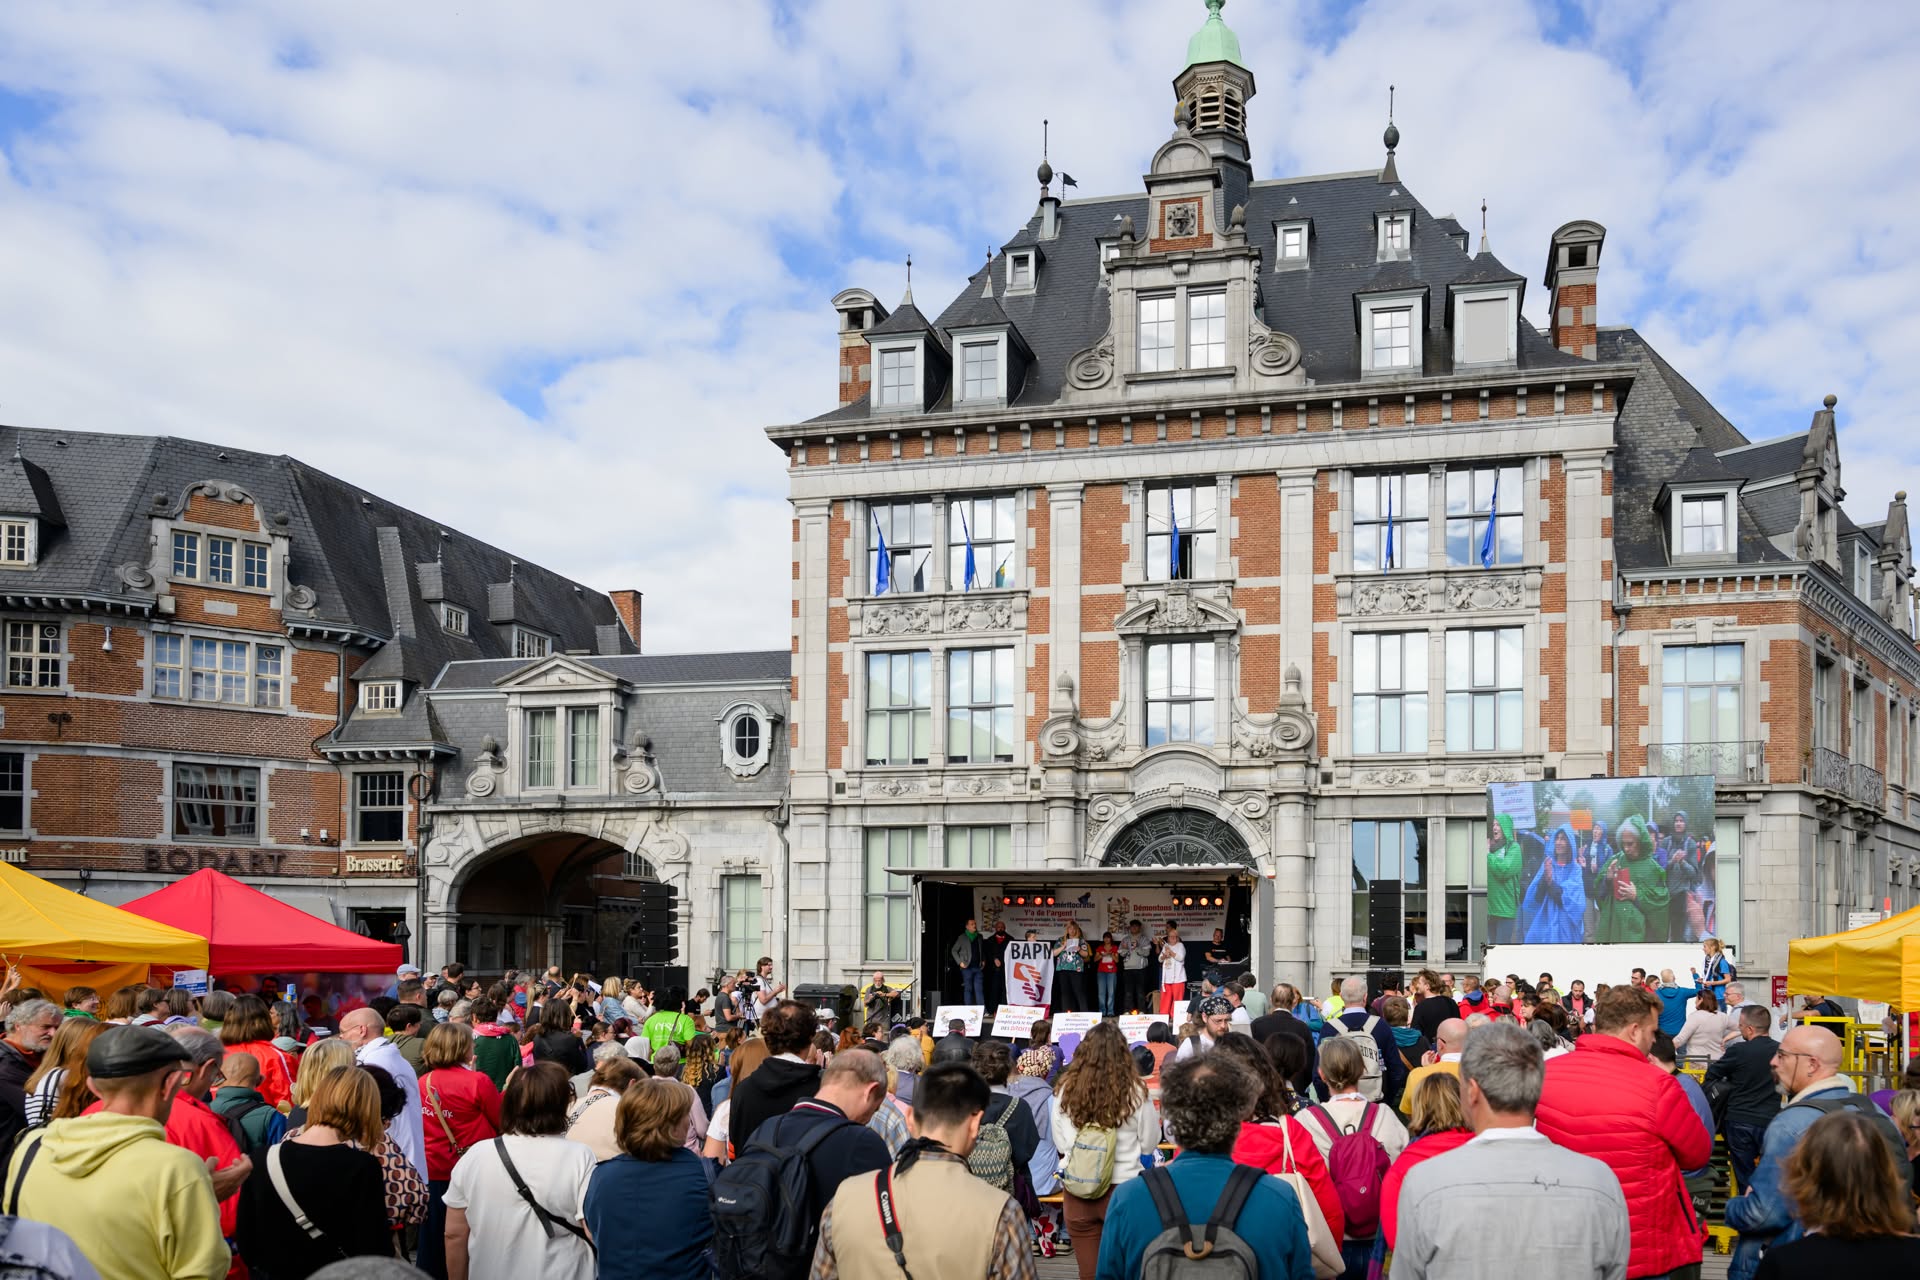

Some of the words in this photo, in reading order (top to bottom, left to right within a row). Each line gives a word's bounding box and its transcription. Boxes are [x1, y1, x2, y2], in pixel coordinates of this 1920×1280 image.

[144, 848, 287, 872] BODART
[346, 854, 403, 872] Brasserie
[881, 1191, 893, 1224] Canon
